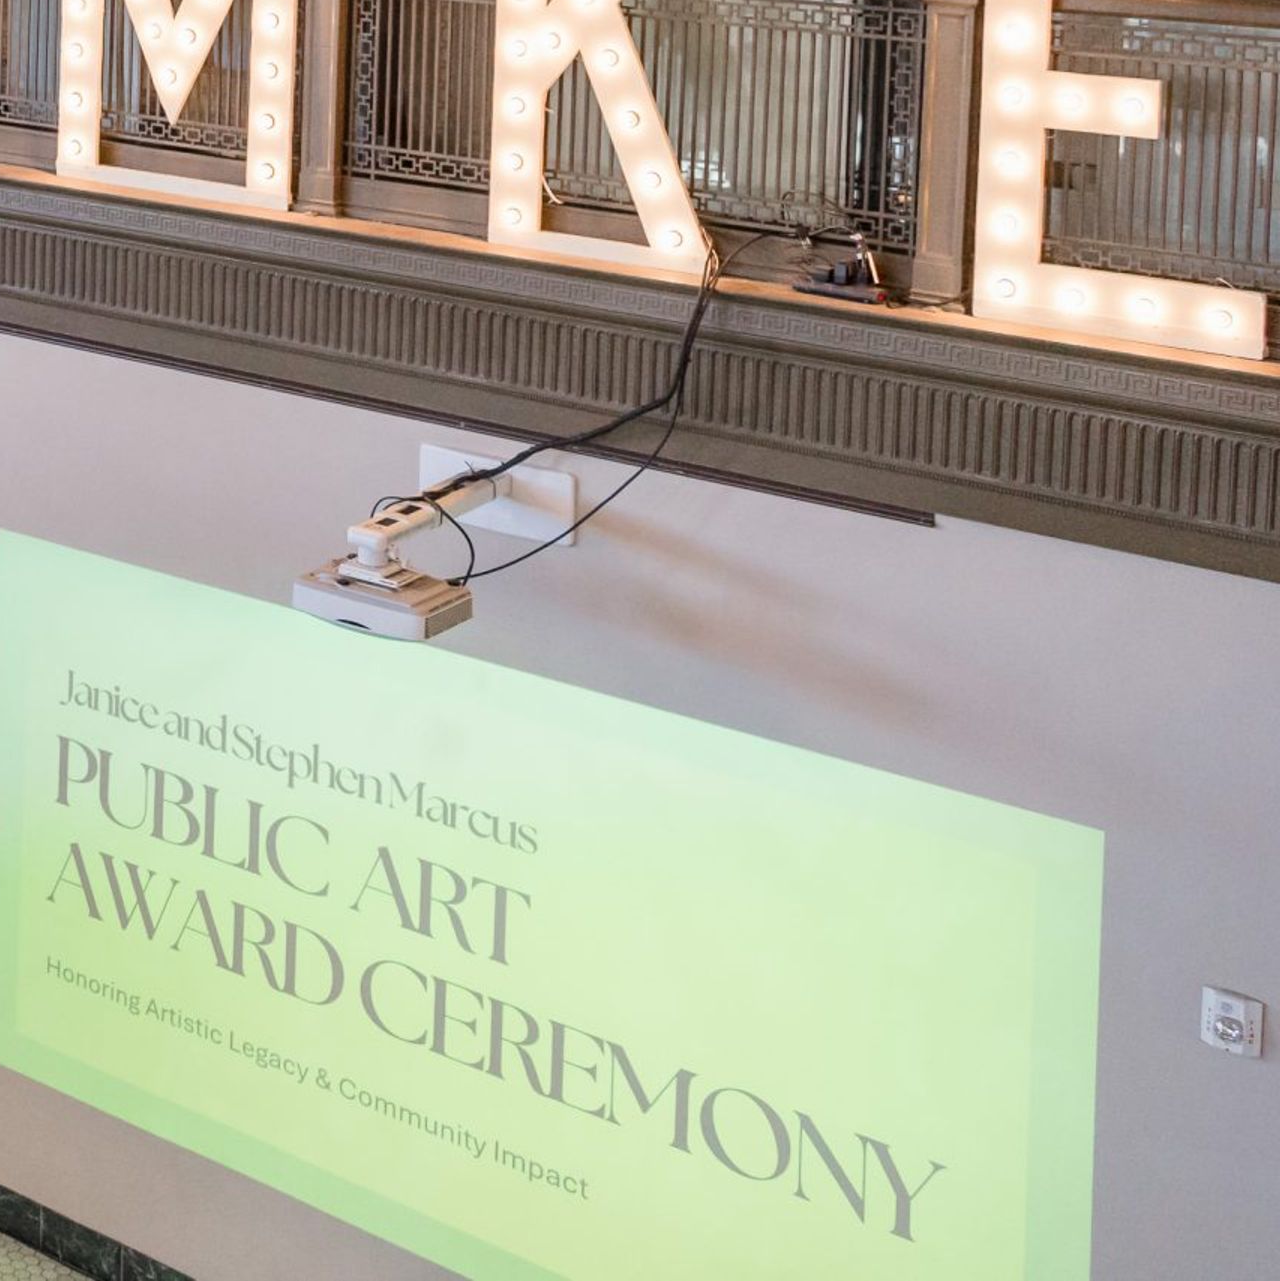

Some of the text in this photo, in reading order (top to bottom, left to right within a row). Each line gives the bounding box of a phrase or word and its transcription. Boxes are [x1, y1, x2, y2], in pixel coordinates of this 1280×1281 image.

[55, 734, 532, 967] PUBLIC ART
[59, 669, 538, 855] Janice and Stephen Marcus
[45, 842, 948, 1243] AWARD CEREMONY
[46, 955, 589, 1200] Honoring Artistic Legacy & Community Impact
